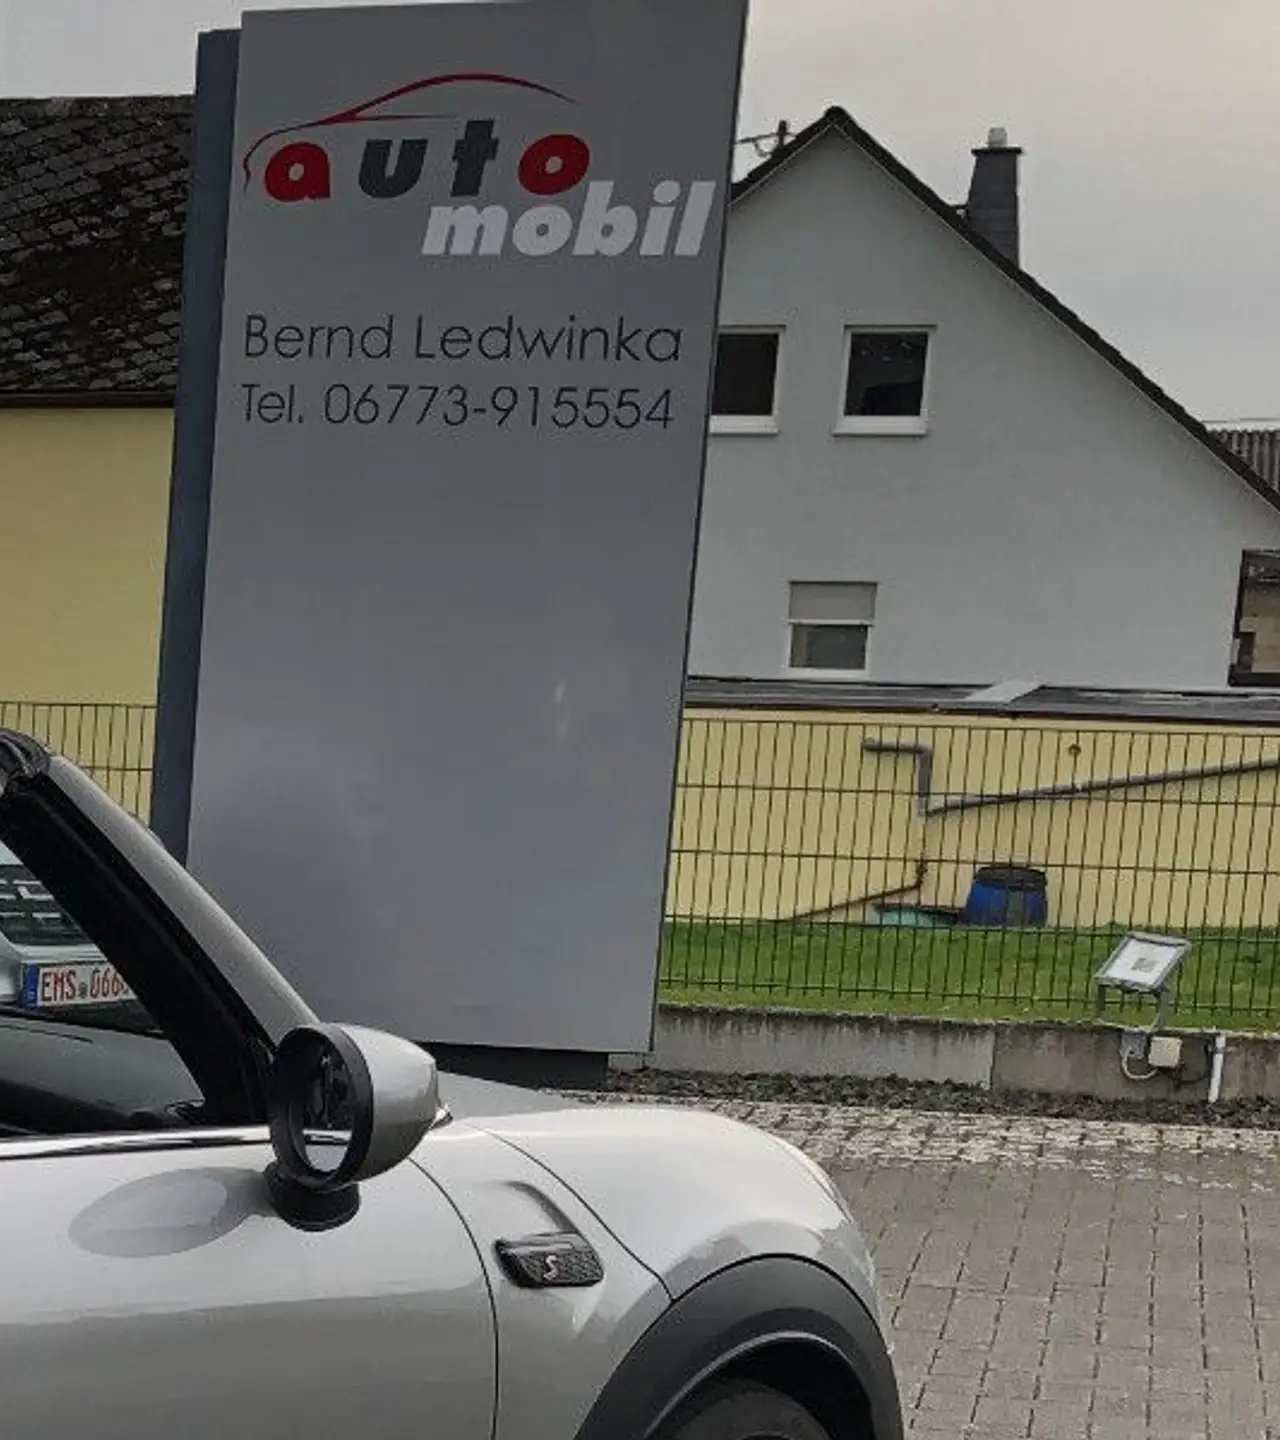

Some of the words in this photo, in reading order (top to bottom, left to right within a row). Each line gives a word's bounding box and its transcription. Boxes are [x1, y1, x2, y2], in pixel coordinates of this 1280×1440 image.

[263, 118, 591, 203] auto
[421, 180, 716, 257] mobil
[243, 314, 394, 361] Bernd
[415, 315, 683, 363] Ledwinka
[242, 383, 304, 424] Tel.
[324, 384, 673, 430] 06773-915554
[41, 970, 77, 1002] EMS
[90, 967, 129, 999] 066
